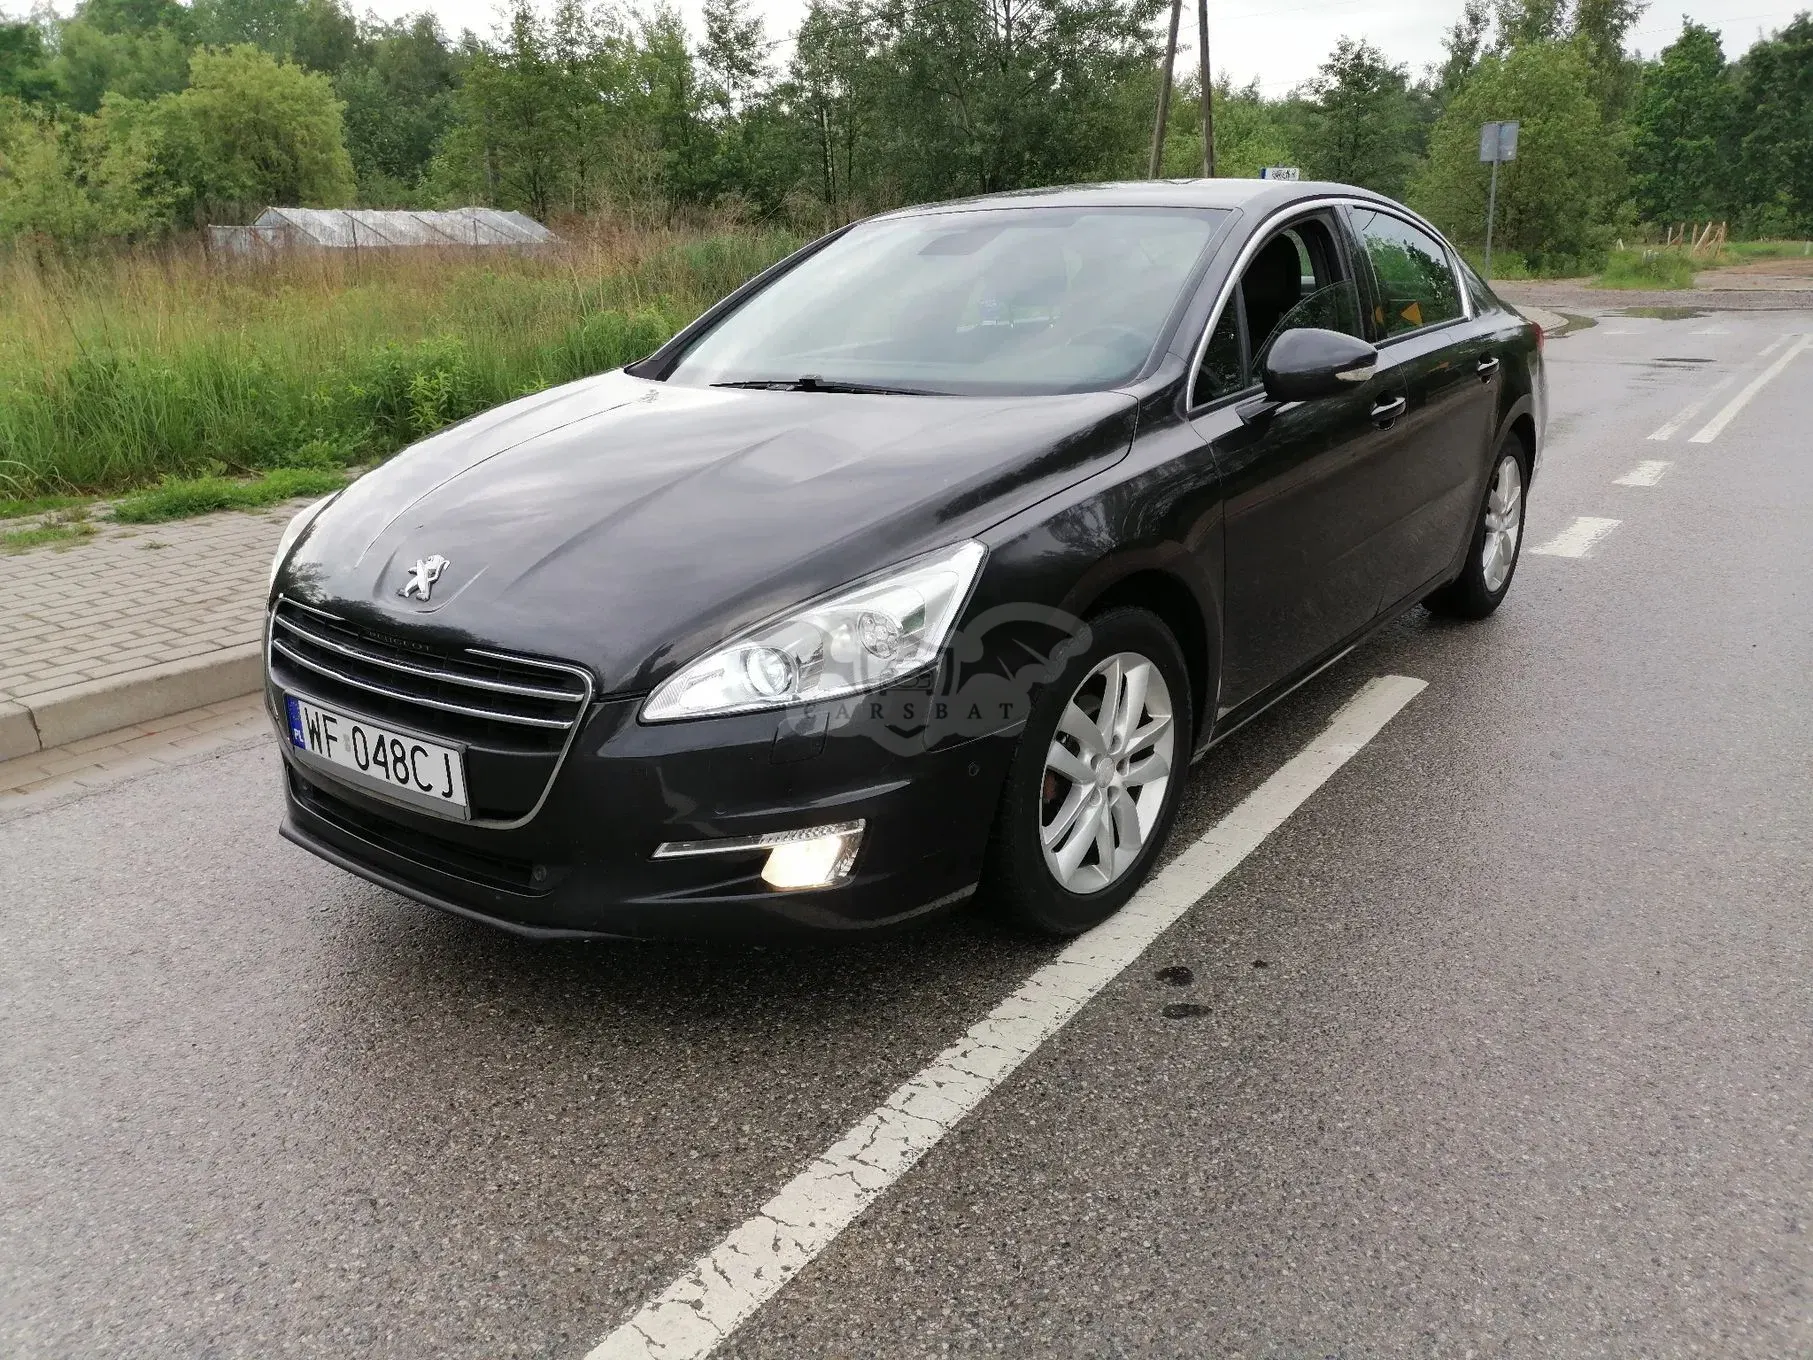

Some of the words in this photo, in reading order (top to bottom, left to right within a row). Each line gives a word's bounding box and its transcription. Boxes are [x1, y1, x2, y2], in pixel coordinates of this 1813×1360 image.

[293, 728, 304, 743] PL
[304, 707, 338, 758] WF
[352, 725, 453, 798] 048CJ
